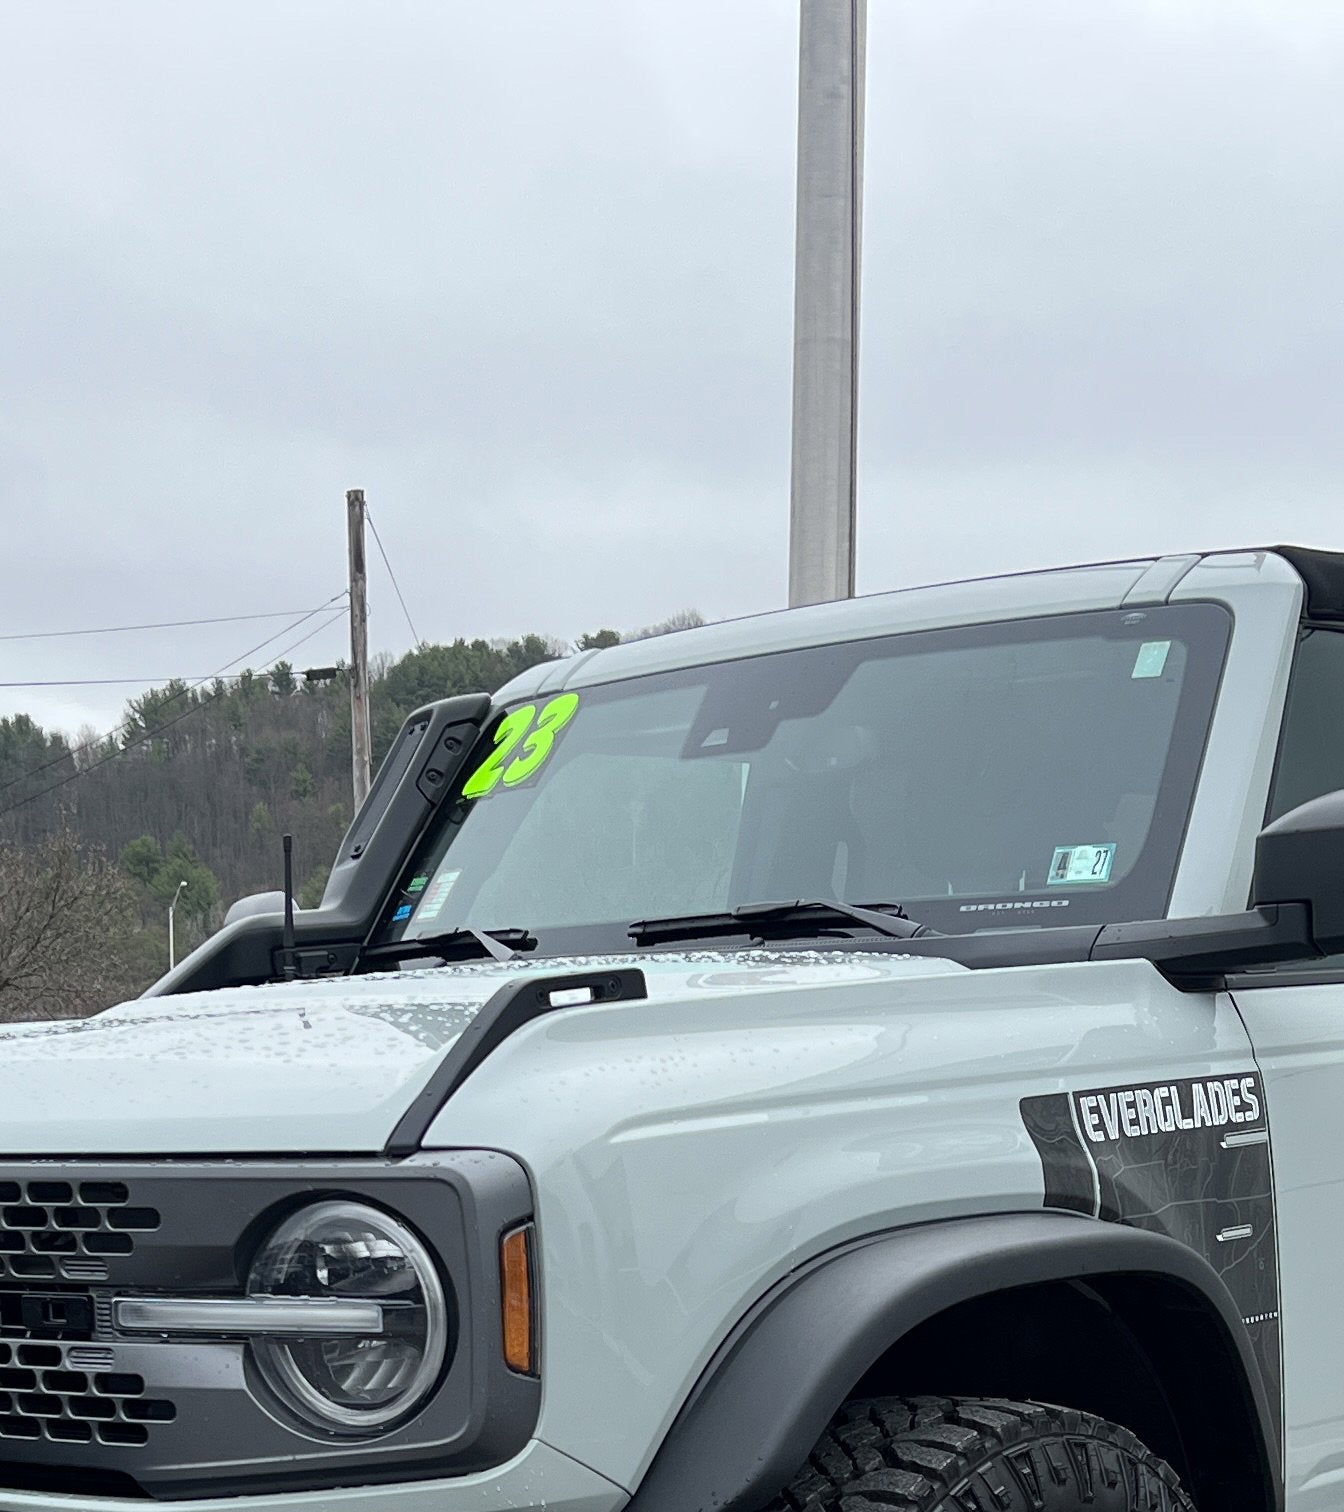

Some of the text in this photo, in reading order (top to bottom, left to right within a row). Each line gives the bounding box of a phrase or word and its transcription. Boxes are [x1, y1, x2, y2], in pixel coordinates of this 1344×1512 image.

[462, 692, 579, 799] 23
[1091, 850, 1109, 875] 27
[959, 900, 1070, 912] BRONCO
[1079, 1076, 1260, 1142] EVERGLADES
